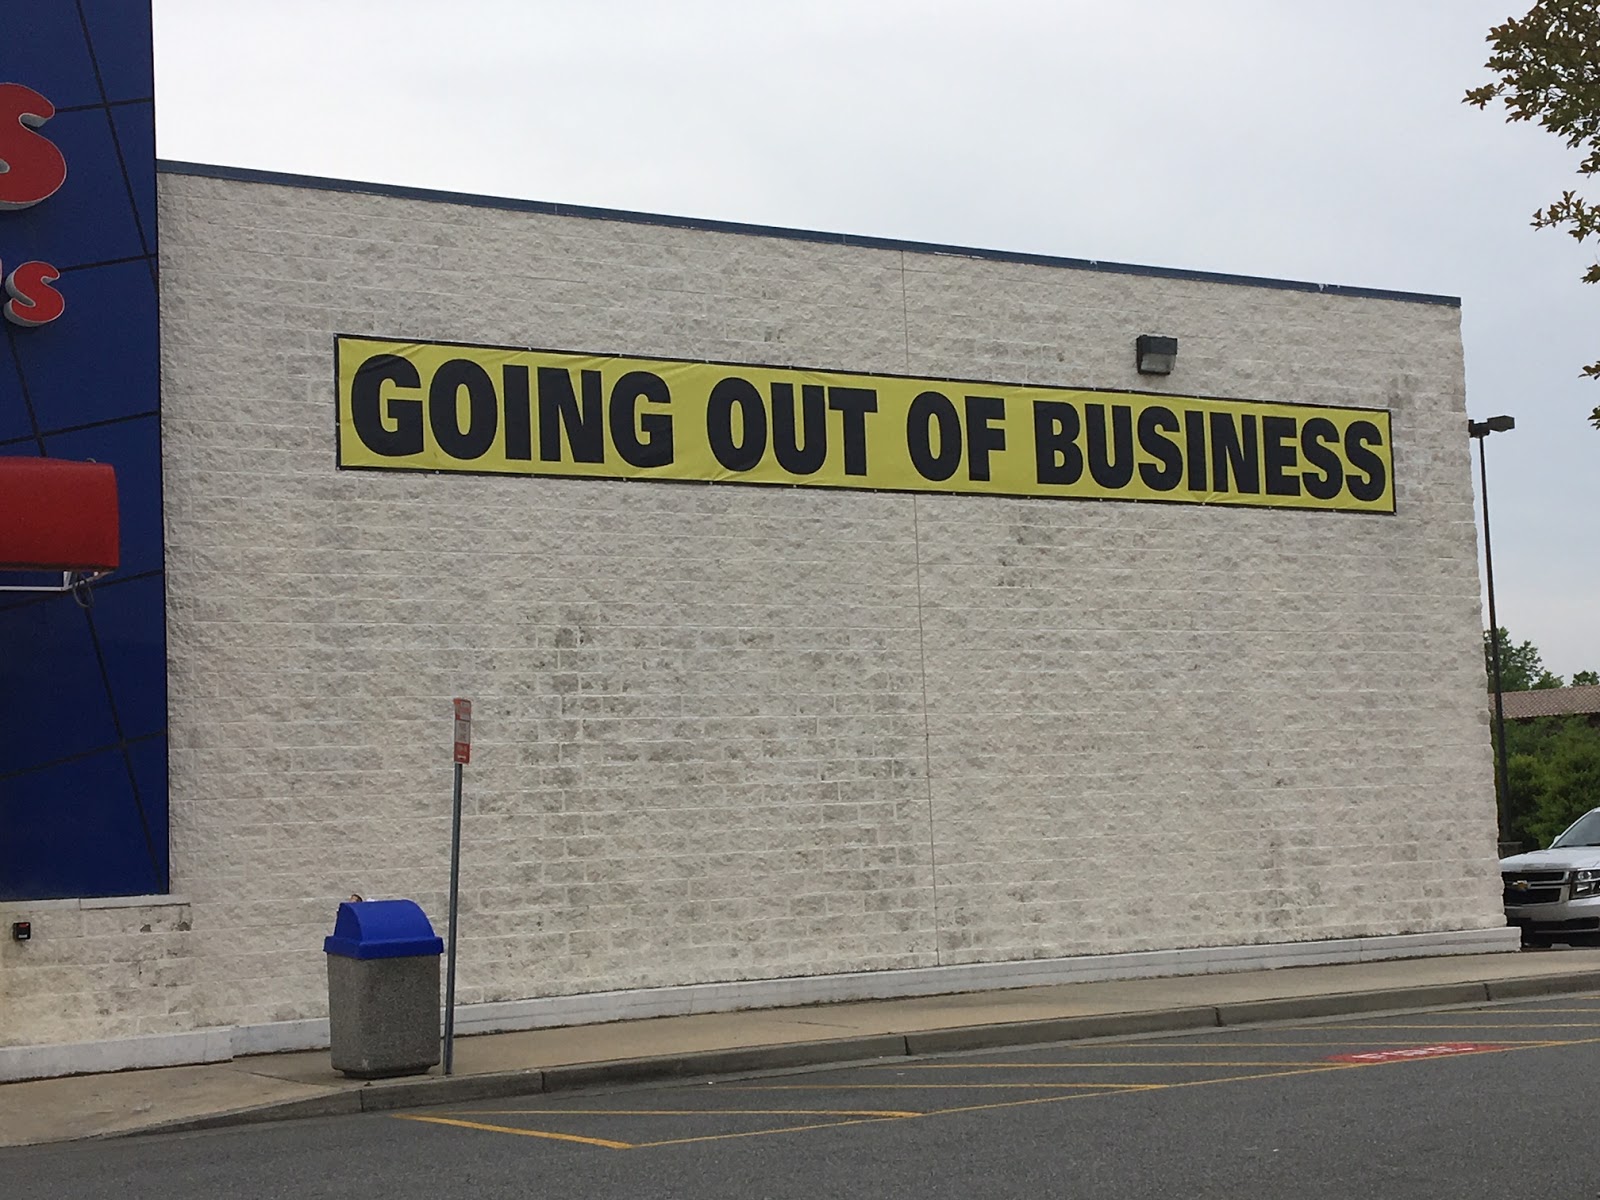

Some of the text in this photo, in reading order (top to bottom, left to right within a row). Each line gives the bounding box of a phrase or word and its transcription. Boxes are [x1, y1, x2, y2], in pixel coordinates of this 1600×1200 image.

[351, 353, 1386, 501] GOING OUT OF BUSINESS
